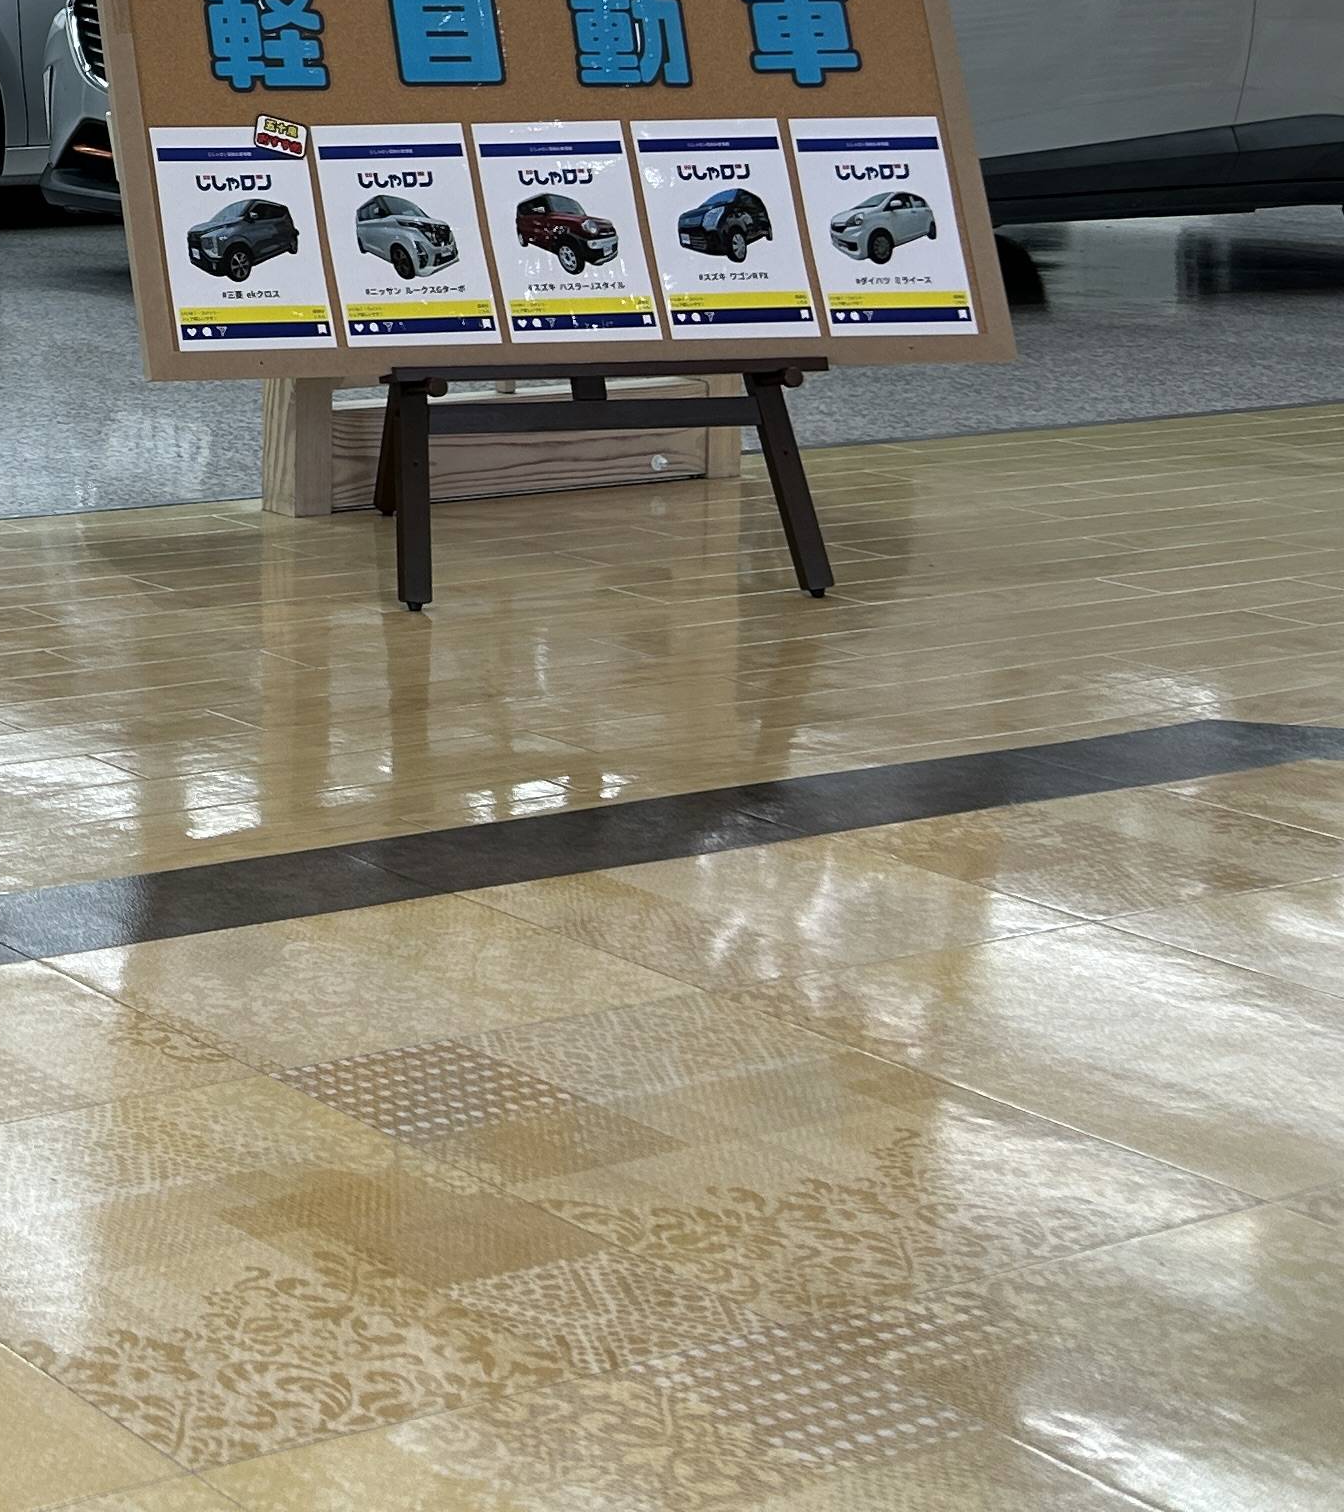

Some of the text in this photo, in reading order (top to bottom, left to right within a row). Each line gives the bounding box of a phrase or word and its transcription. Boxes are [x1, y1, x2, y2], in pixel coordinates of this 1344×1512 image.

[357, 171, 433, 188] じしゃロン
[518, 168, 593, 186] じしゃロン
[677, 163, 750, 181] じしゃロン
[835, 163, 909, 181] じしゃロン
[196, 174, 272, 191] じしゃロン
